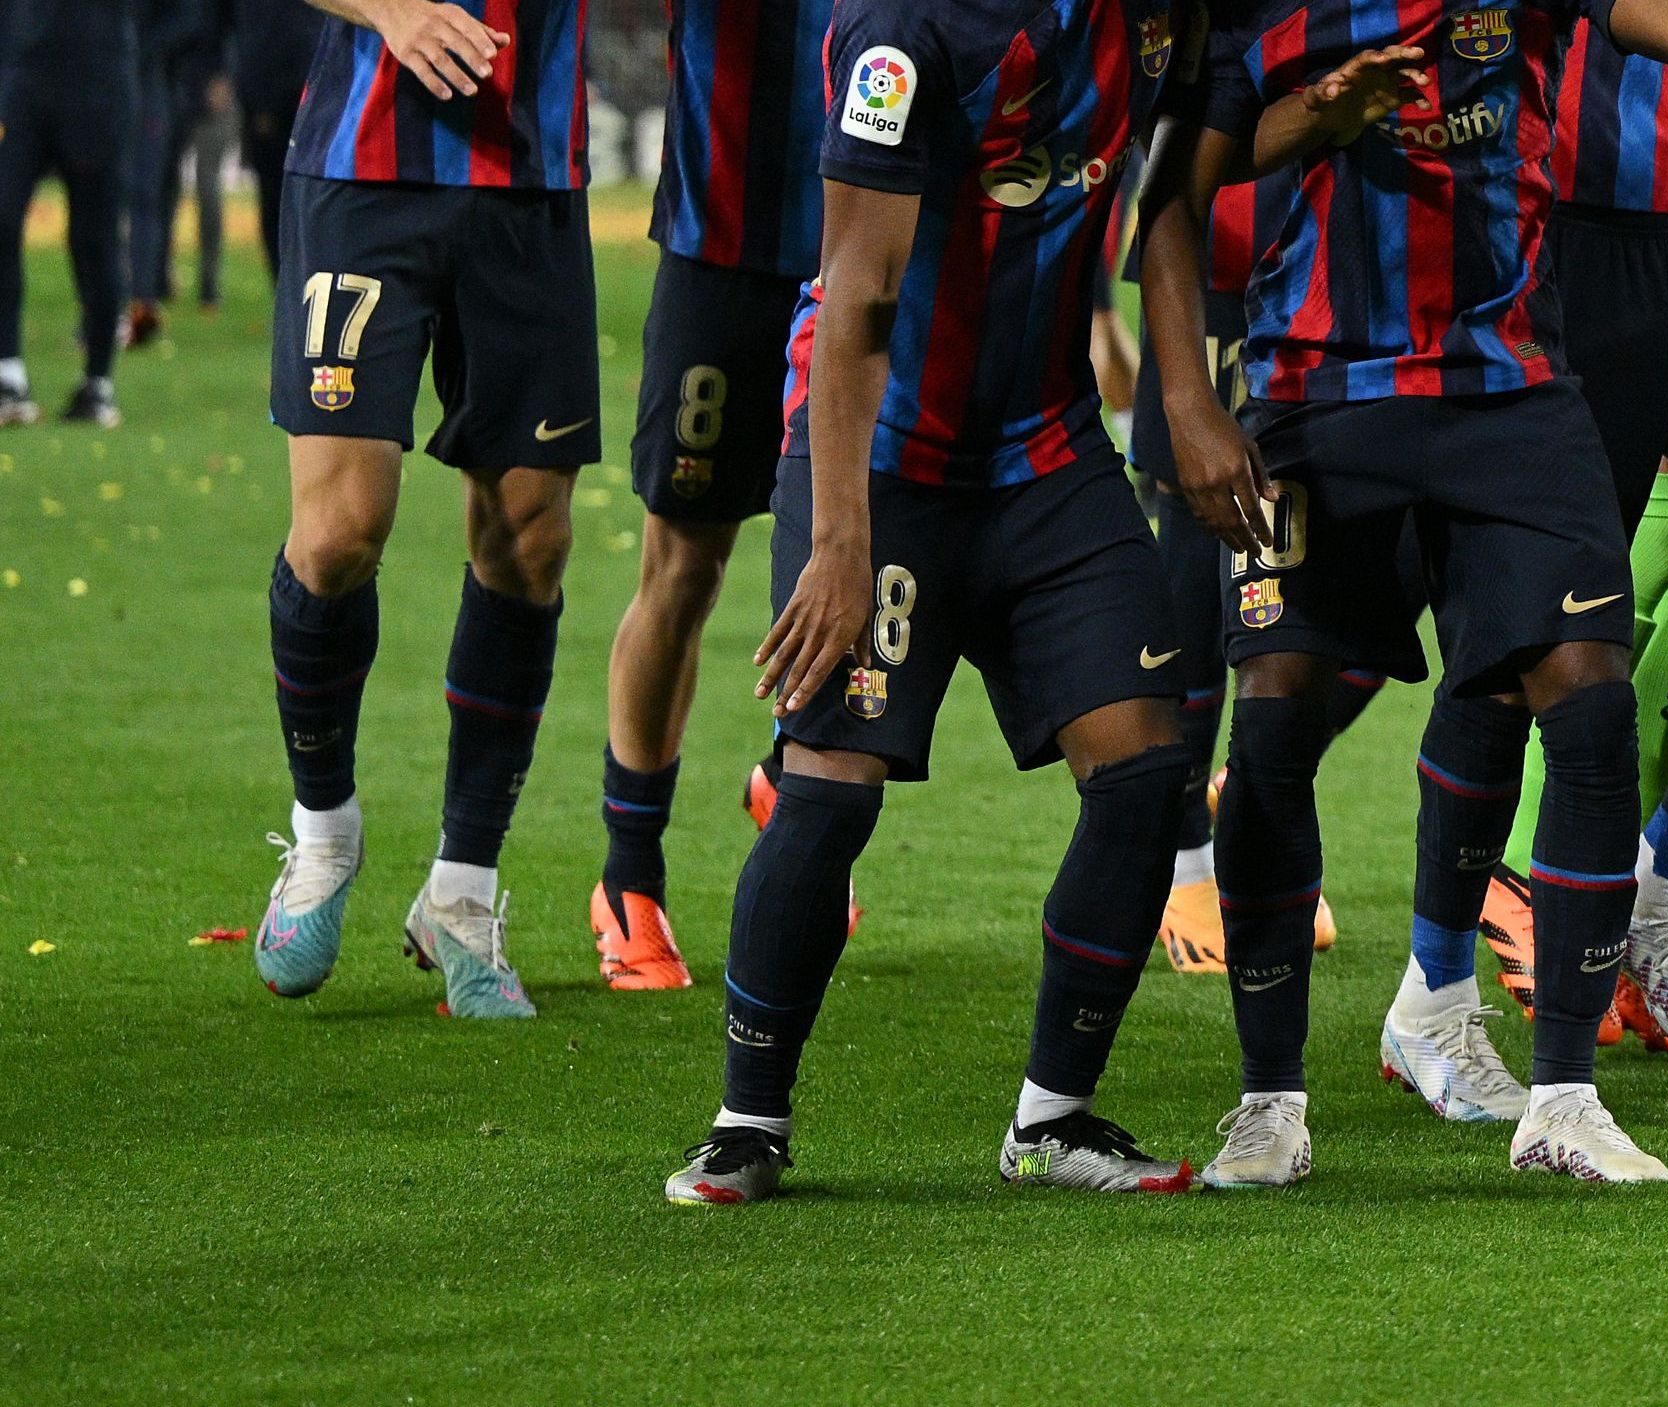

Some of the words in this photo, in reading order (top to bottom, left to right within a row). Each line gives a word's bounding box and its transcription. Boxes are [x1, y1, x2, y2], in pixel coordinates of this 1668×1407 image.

[849, 107, 899, 133] LaLiga
[1376, 102, 1505, 150] potify
[303, 271, 382, 359] 17
[676, 365, 727, 450] 8
[1251, 598, 1269, 606] FCB
[1234, 963, 1292, 978] CULERS
[729, 1013, 775, 1043] CULERS
